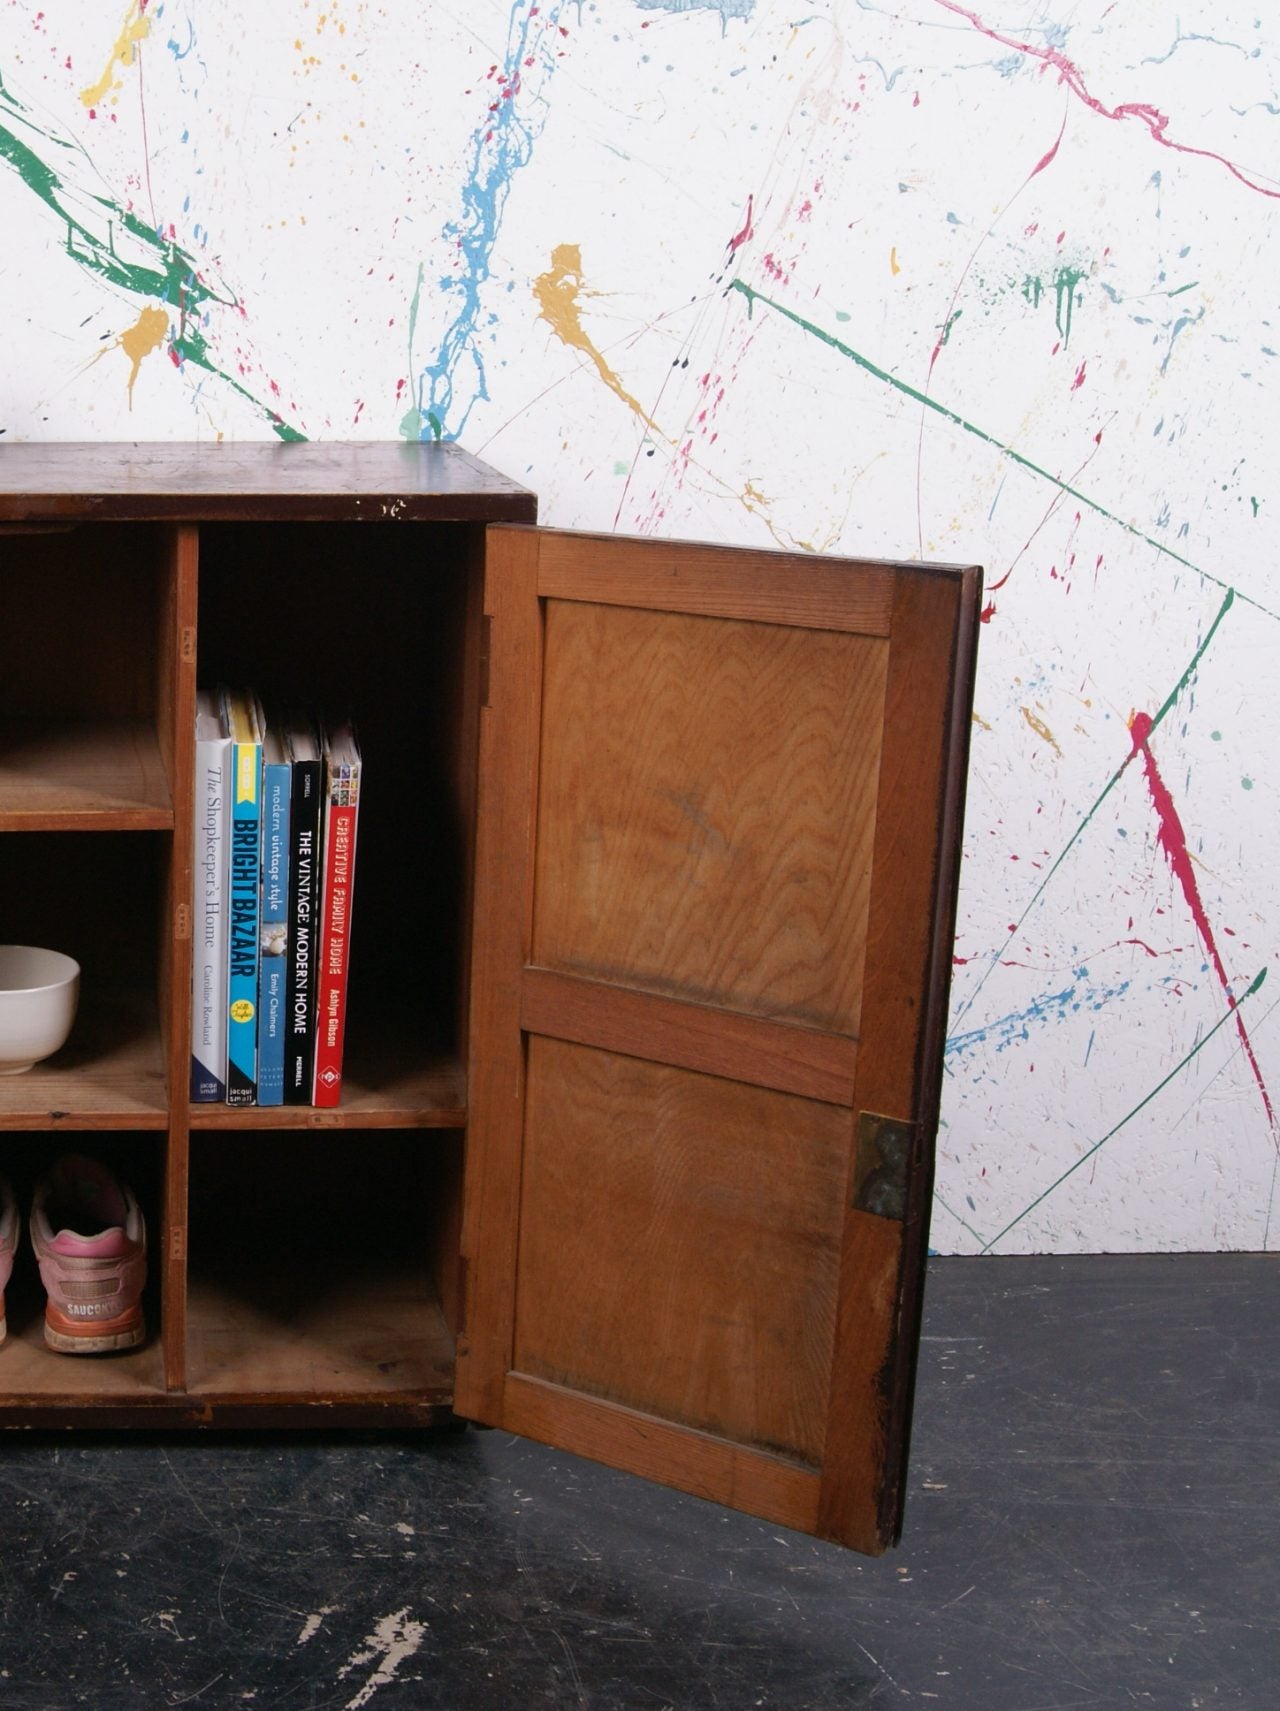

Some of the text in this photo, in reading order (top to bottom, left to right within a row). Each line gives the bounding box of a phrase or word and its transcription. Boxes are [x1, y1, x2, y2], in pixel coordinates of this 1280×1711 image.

[202, 767, 222, 948] The Shopkeeper's Home
[231, 819, 258, 977] BRIGHT BAZAAR
[267, 786, 283, 911] modern vintage style
[329, 816, 350, 975] CREATIVE FAMILY HOME
[294, 831, 312, 1034] THE VINTAGE MODERN HOME
[202, 965, 213, 1046] Caroline Rowland
[268, 973, 280, 1038] Emily Chalmers
[327, 989, 341, 1047] Ashlyn Gibson
[229, 1087, 252, 1096] jacqui
[295, 1056, 303, 1087] MERRELL
